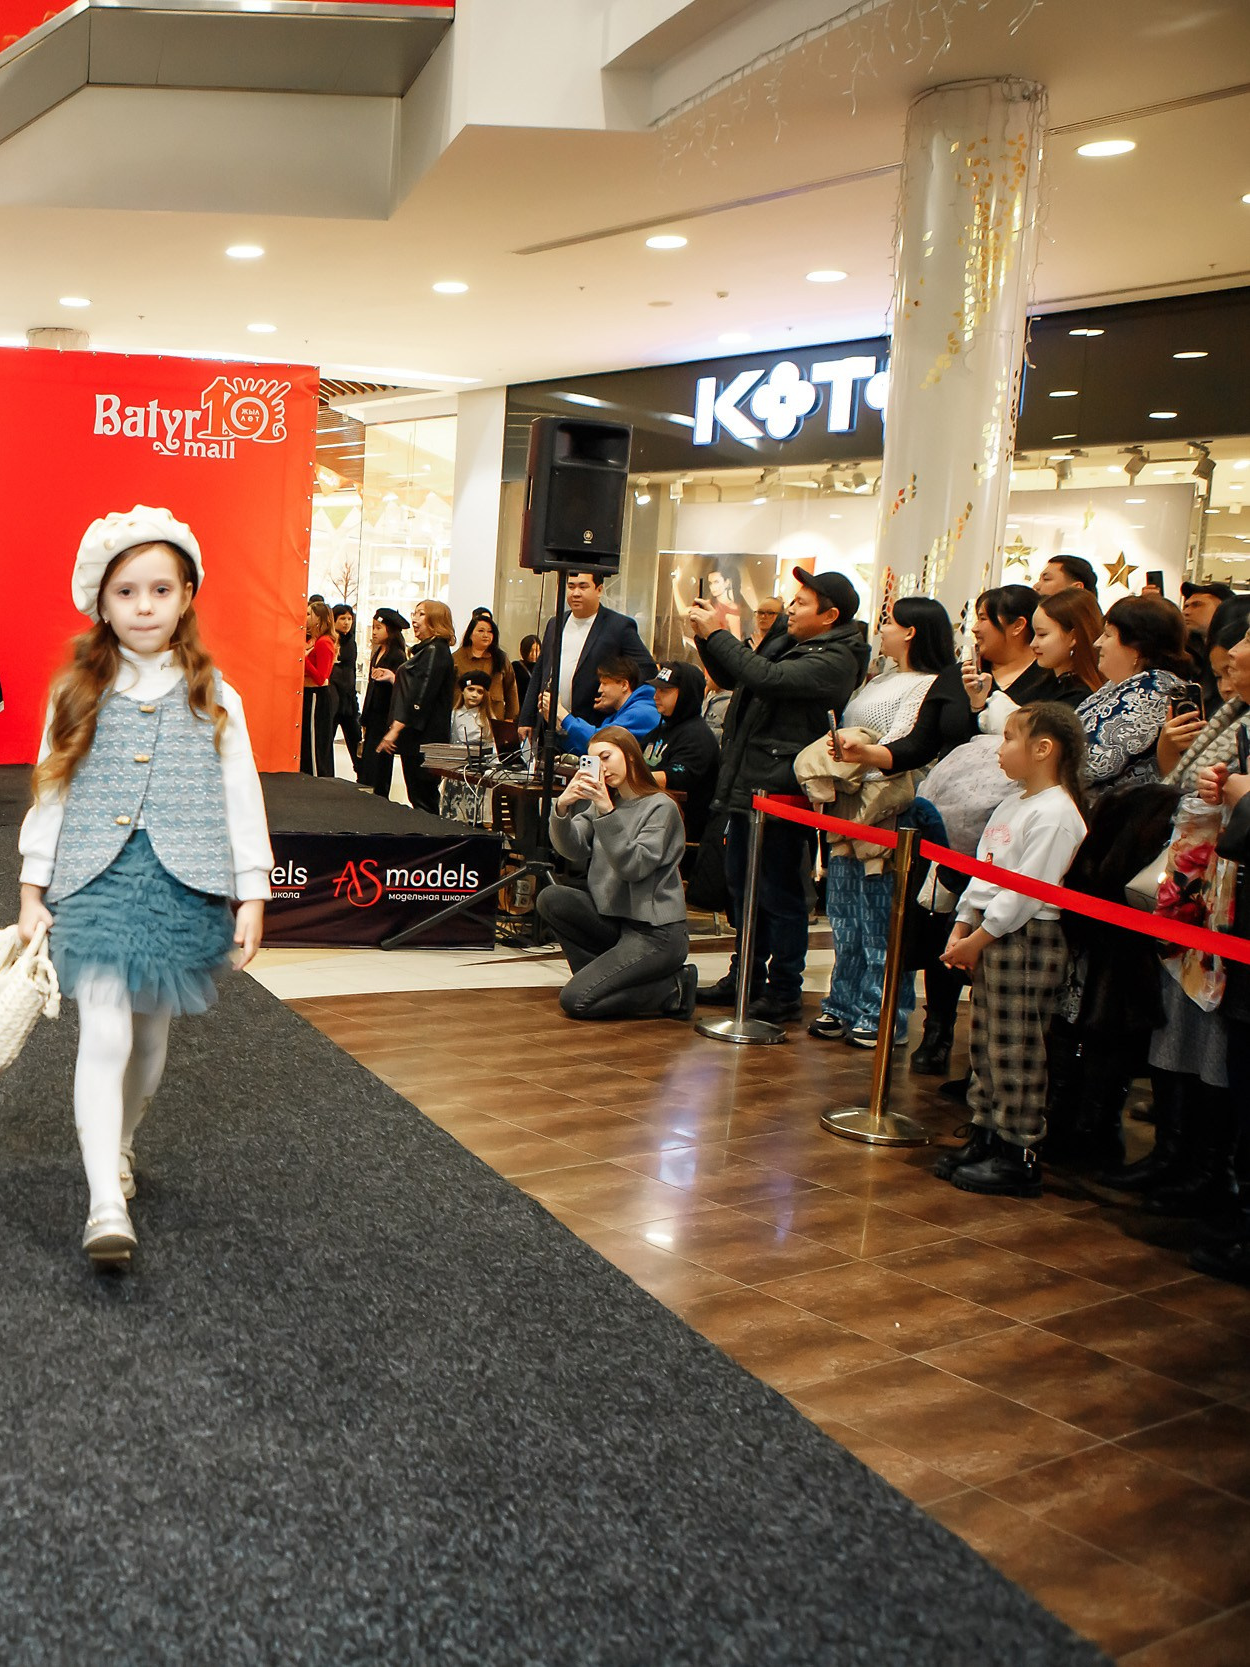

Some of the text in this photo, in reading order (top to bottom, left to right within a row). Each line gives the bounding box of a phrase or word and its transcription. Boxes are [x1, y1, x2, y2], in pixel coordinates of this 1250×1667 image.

[93, 394, 201, 455] Batyr
[183, 440, 235, 459] mall
[332, 859, 479, 907] AS models
[388, 893, 440, 902] модельная
